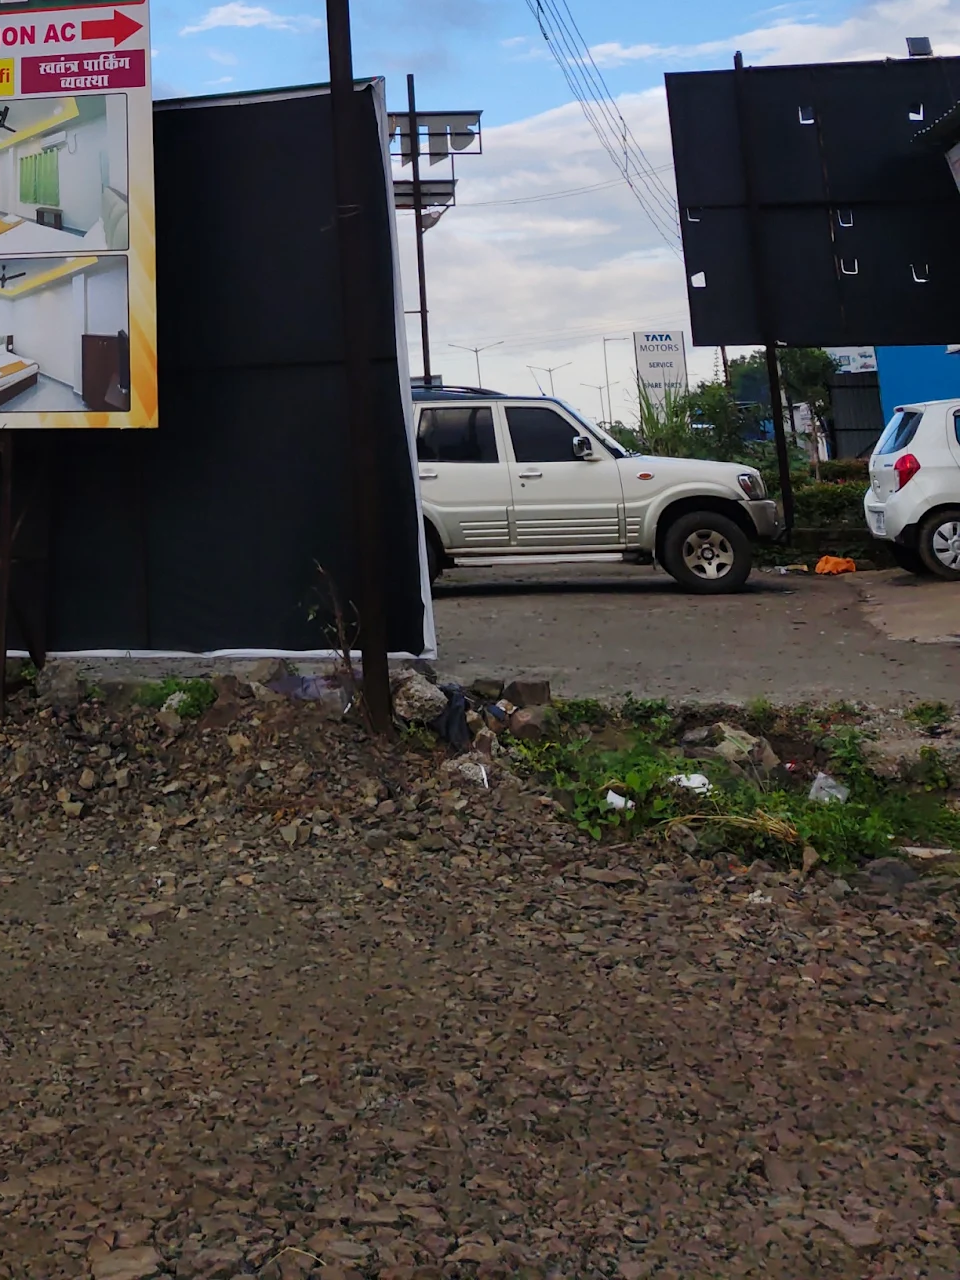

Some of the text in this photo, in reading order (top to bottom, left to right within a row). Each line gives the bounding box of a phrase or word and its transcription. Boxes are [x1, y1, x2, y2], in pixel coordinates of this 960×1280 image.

[43, 22, 76, 44] AC
[644, 334, 672, 342] TATA
[640, 344, 680, 352] MOTORS
